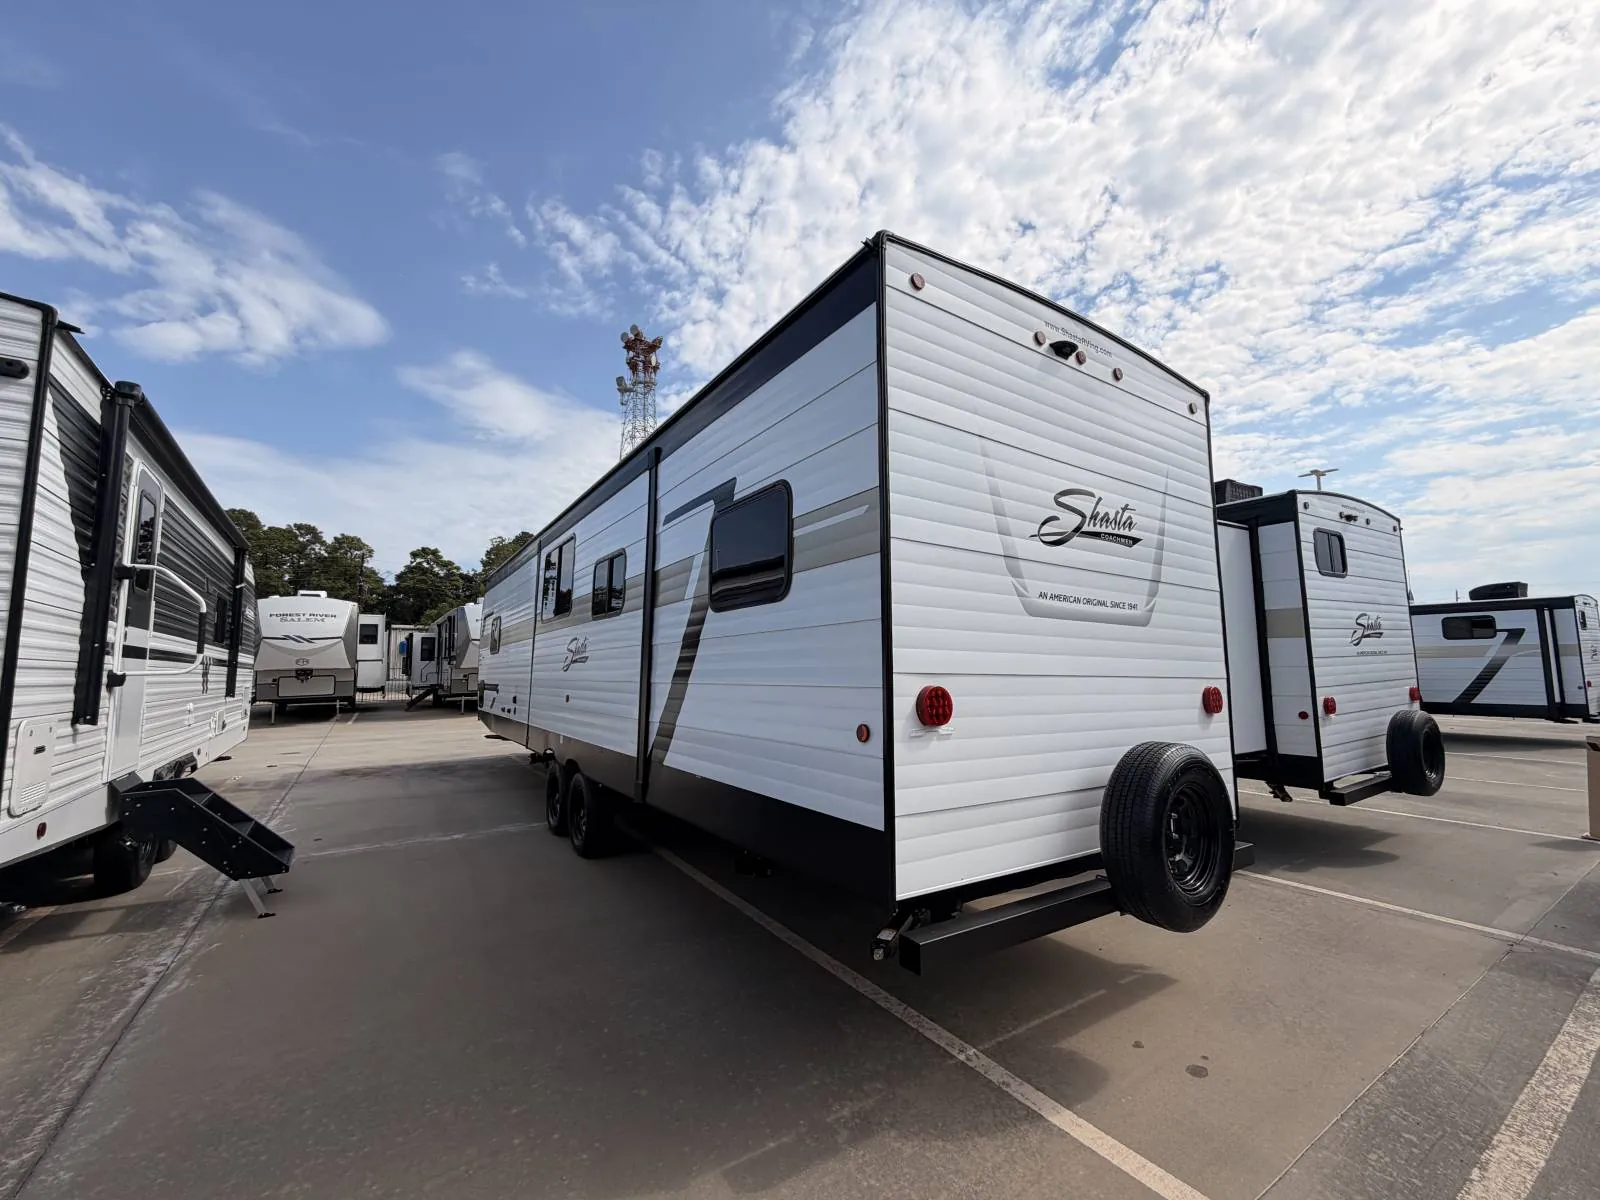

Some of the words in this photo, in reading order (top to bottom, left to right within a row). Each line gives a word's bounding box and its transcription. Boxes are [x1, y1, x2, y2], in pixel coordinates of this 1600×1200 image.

[1036, 488, 1138, 547] Shasta
[1038, 591, 1048, 600] AN
[1049, 593, 1081, 605] AMERICAN
[1082, 597, 1109, 608] ORIGINAL
[1110, 600, 1126, 610] SINCE
[1127, 603, 1138, 611] 1941
